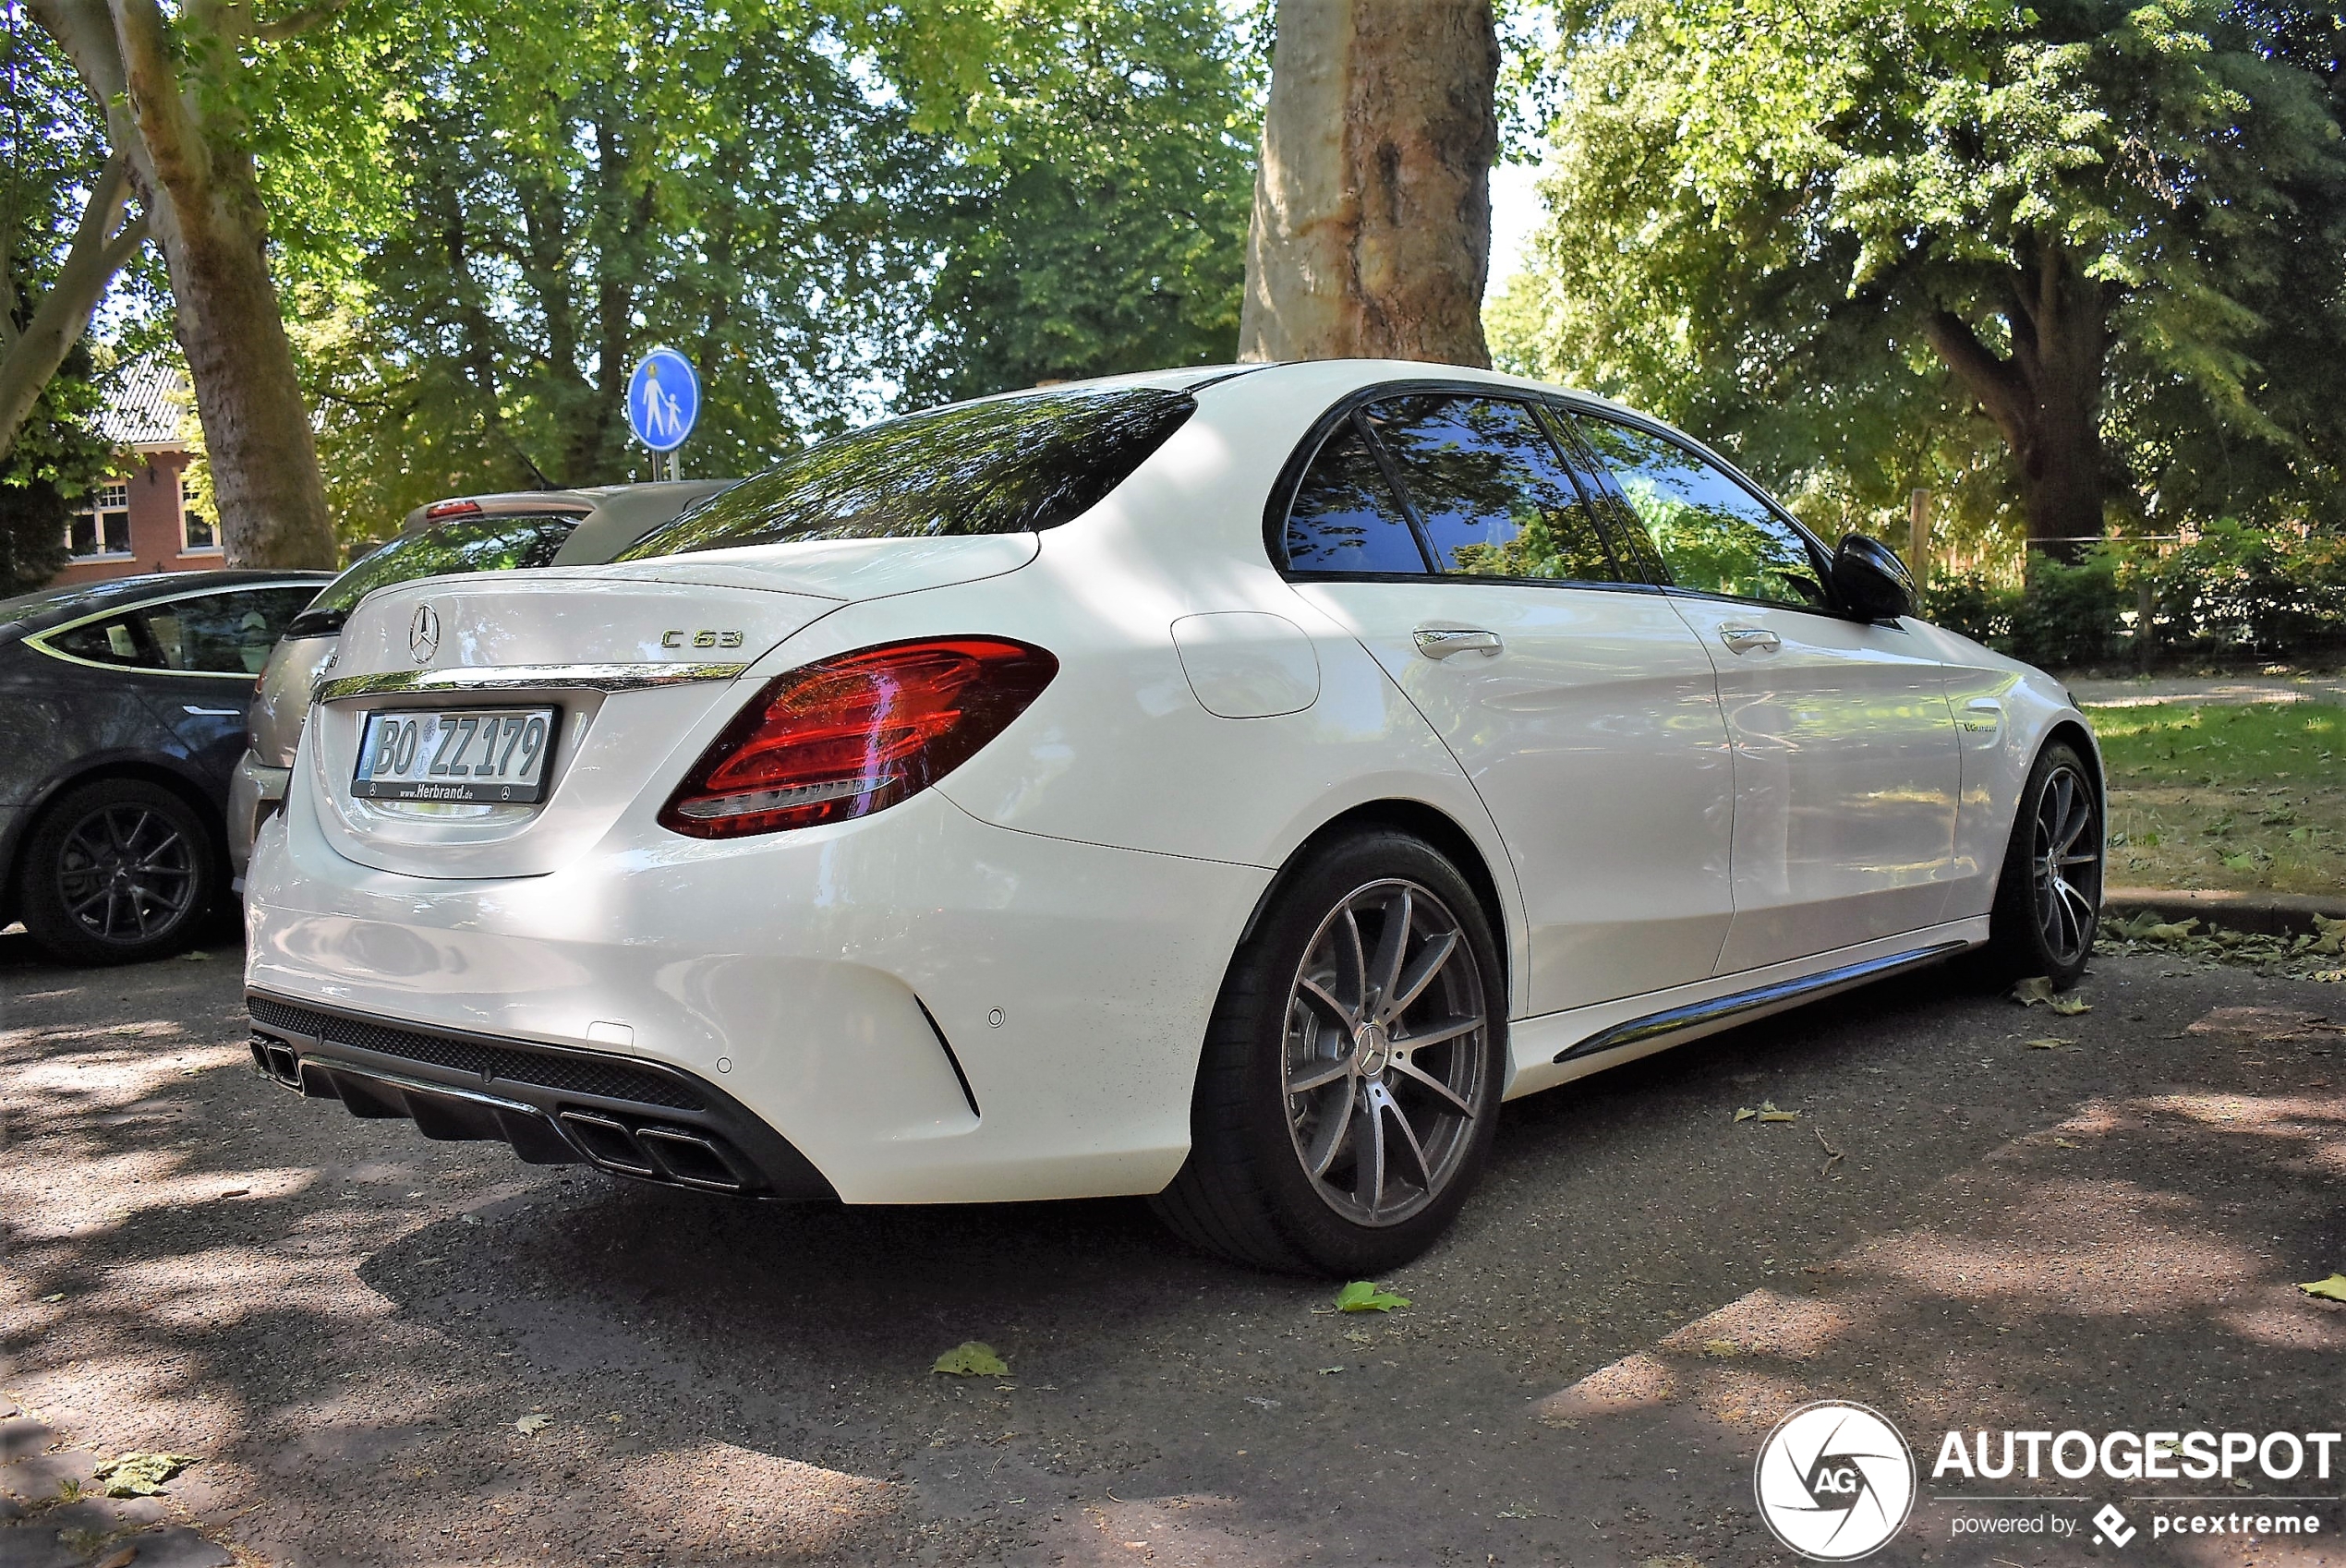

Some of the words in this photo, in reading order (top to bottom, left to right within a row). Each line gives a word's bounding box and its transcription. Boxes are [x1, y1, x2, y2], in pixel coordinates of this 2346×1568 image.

[660, 630, 684, 648] C
[692, 630, 744, 648] 63
[374, 720, 417, 774] BO
[399, 783, 474, 800] www.Herbrand.de
